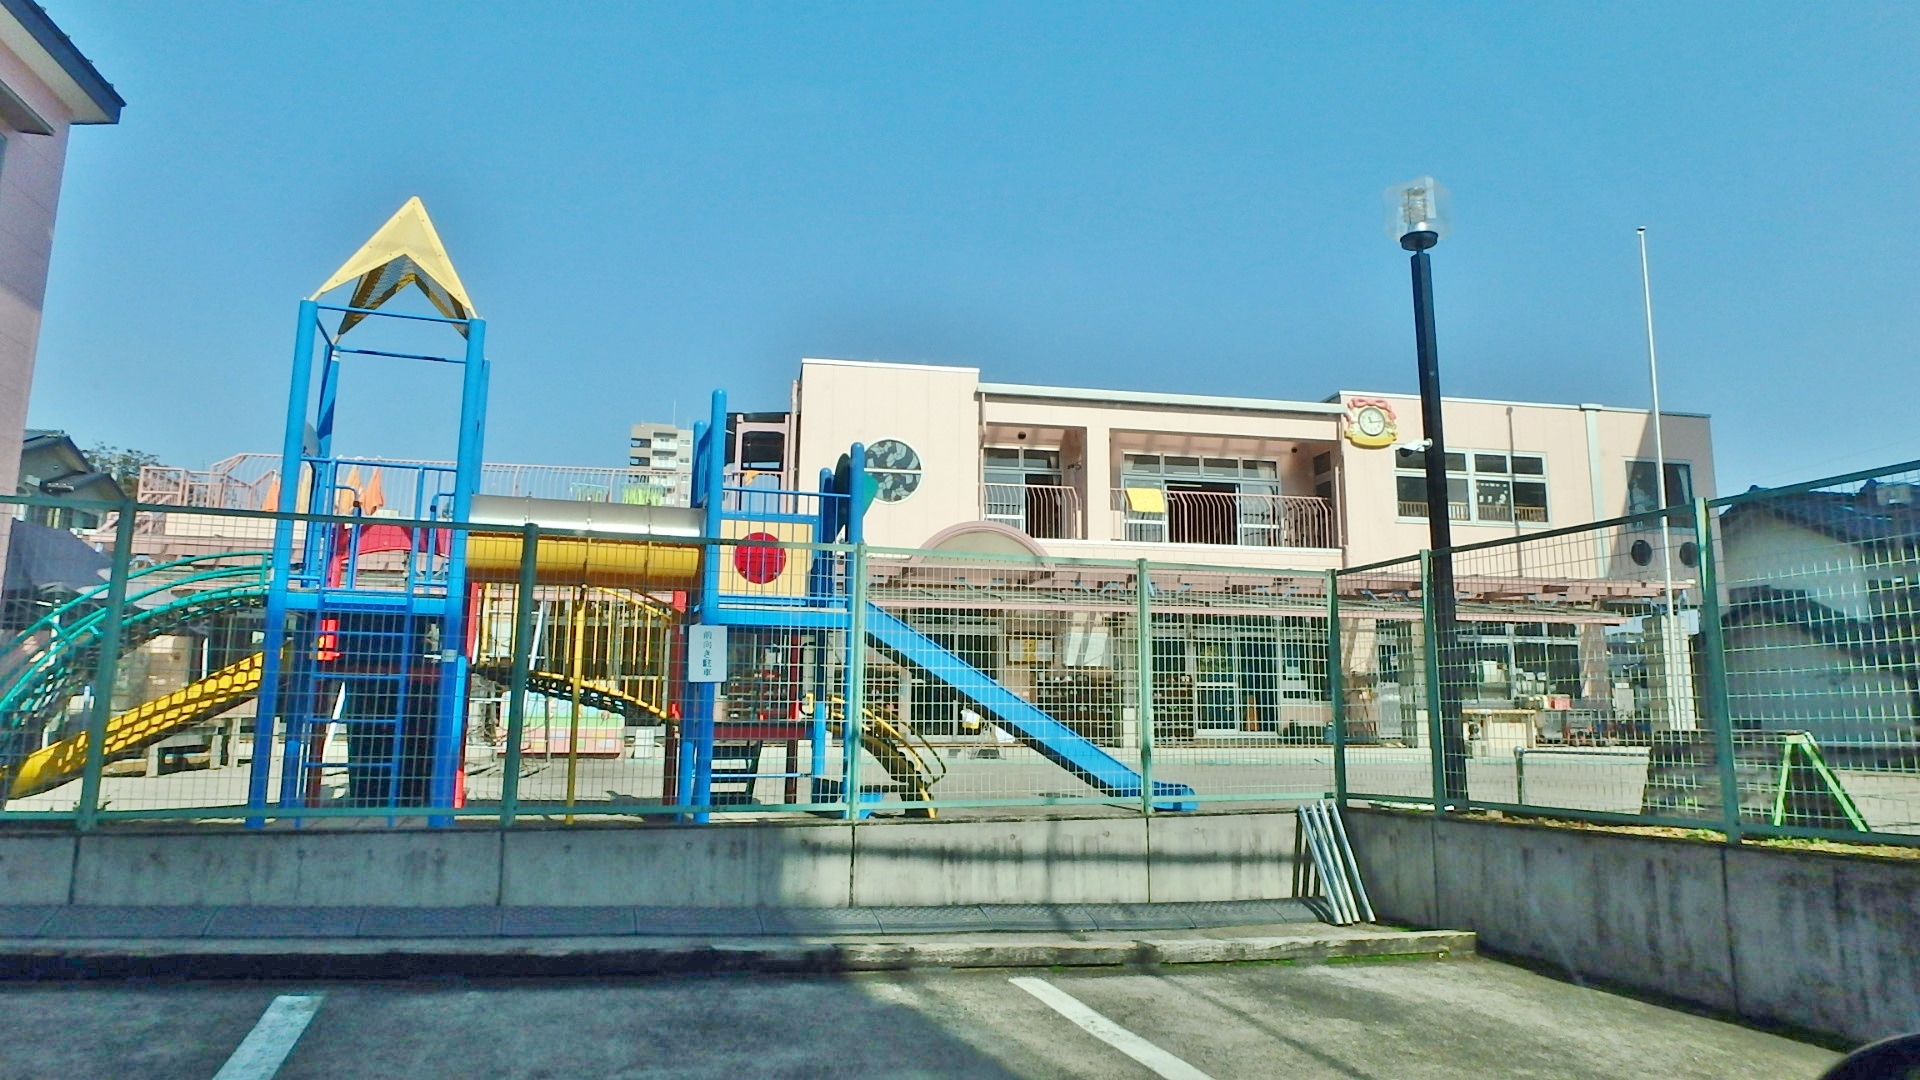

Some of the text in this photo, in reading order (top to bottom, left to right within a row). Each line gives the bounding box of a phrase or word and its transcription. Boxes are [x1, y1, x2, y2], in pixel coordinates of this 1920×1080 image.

[702, 630, 713, 676] 前向き駐車
